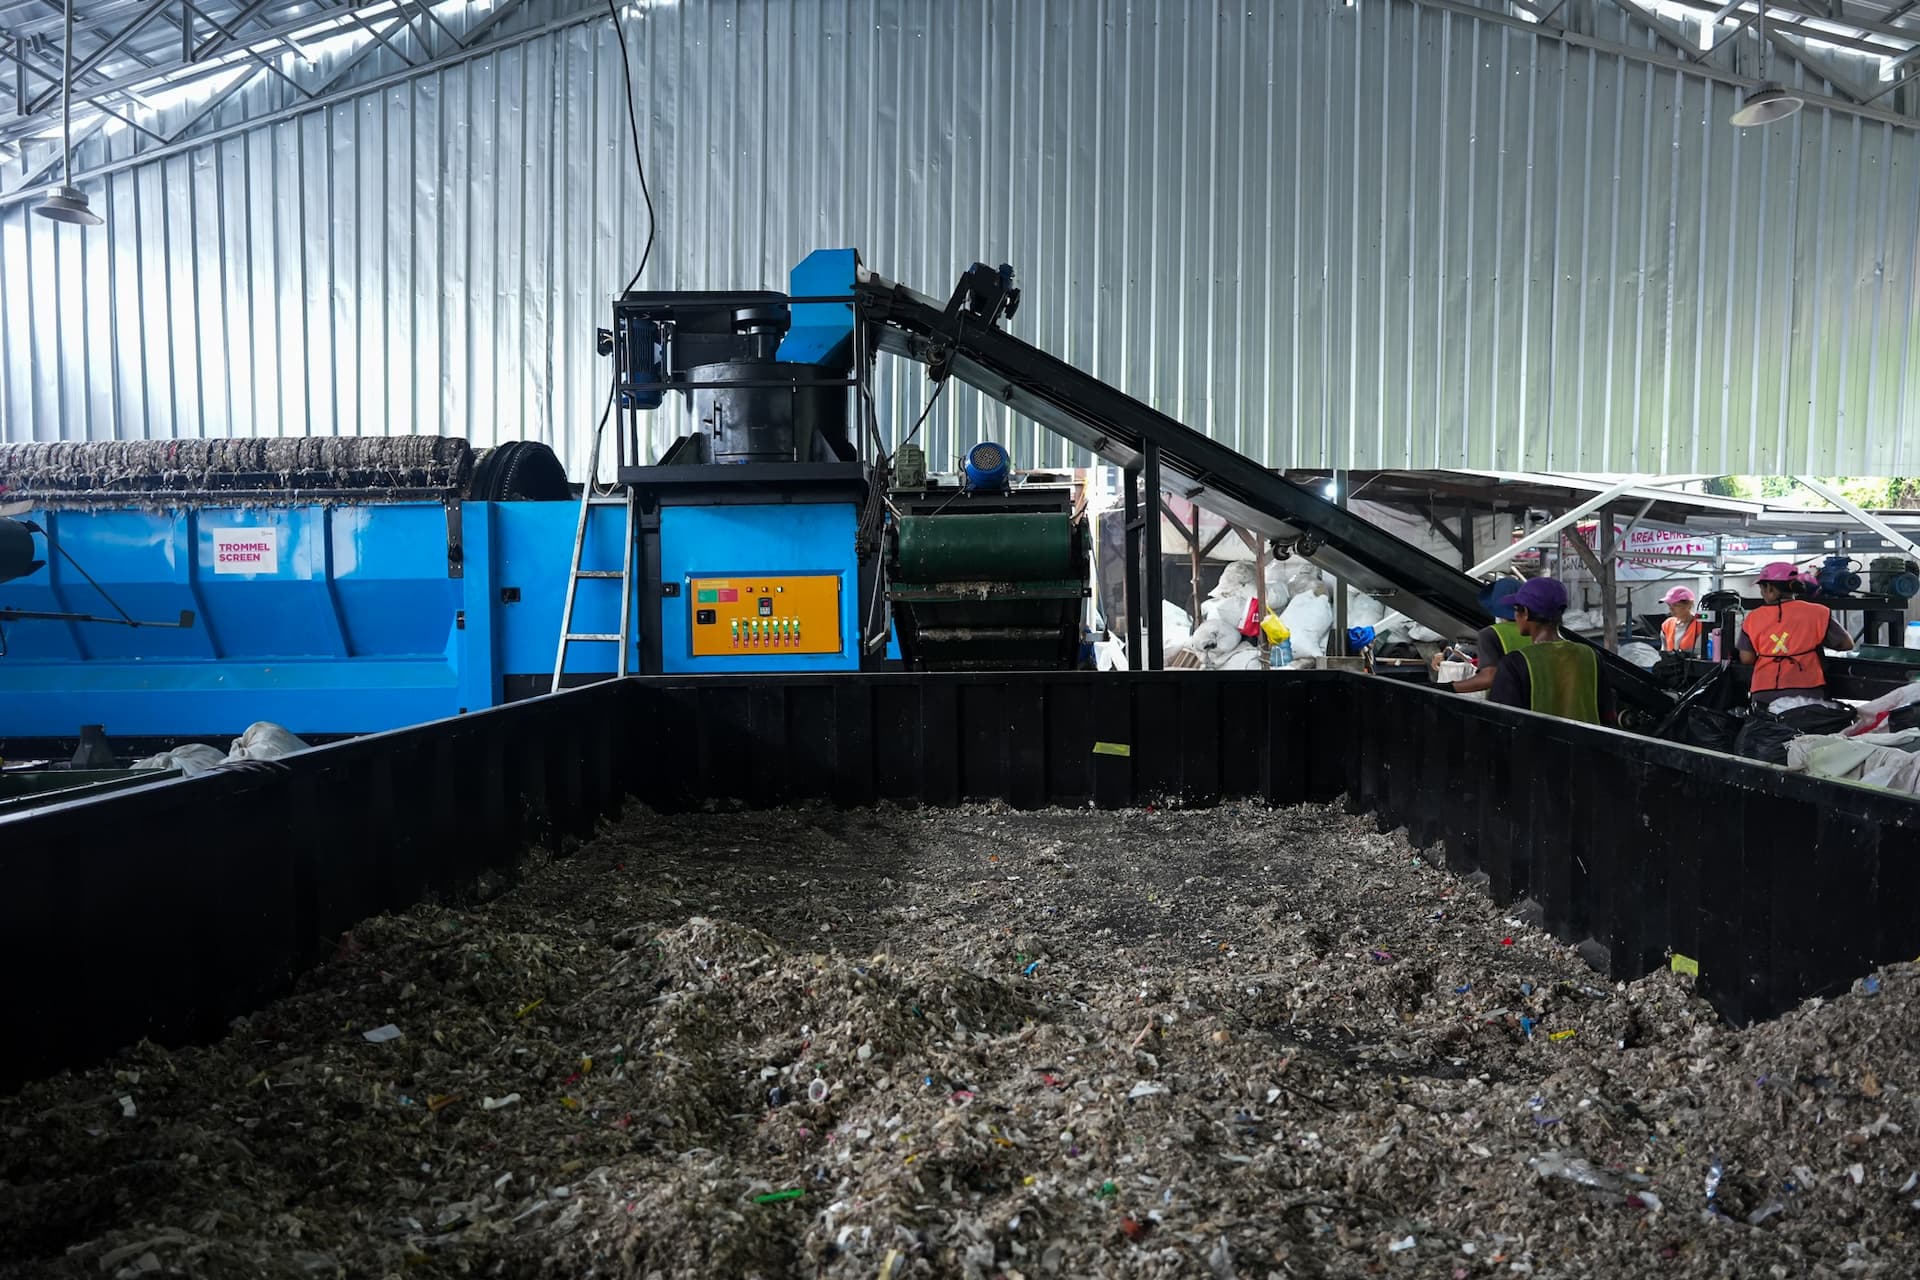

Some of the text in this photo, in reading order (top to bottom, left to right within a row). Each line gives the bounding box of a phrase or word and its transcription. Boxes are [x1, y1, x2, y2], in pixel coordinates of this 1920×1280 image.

[1631, 531, 1655, 545] AREA
[219, 543, 270, 552] TROMMEL
[219, 553, 261, 562] SCREEN
